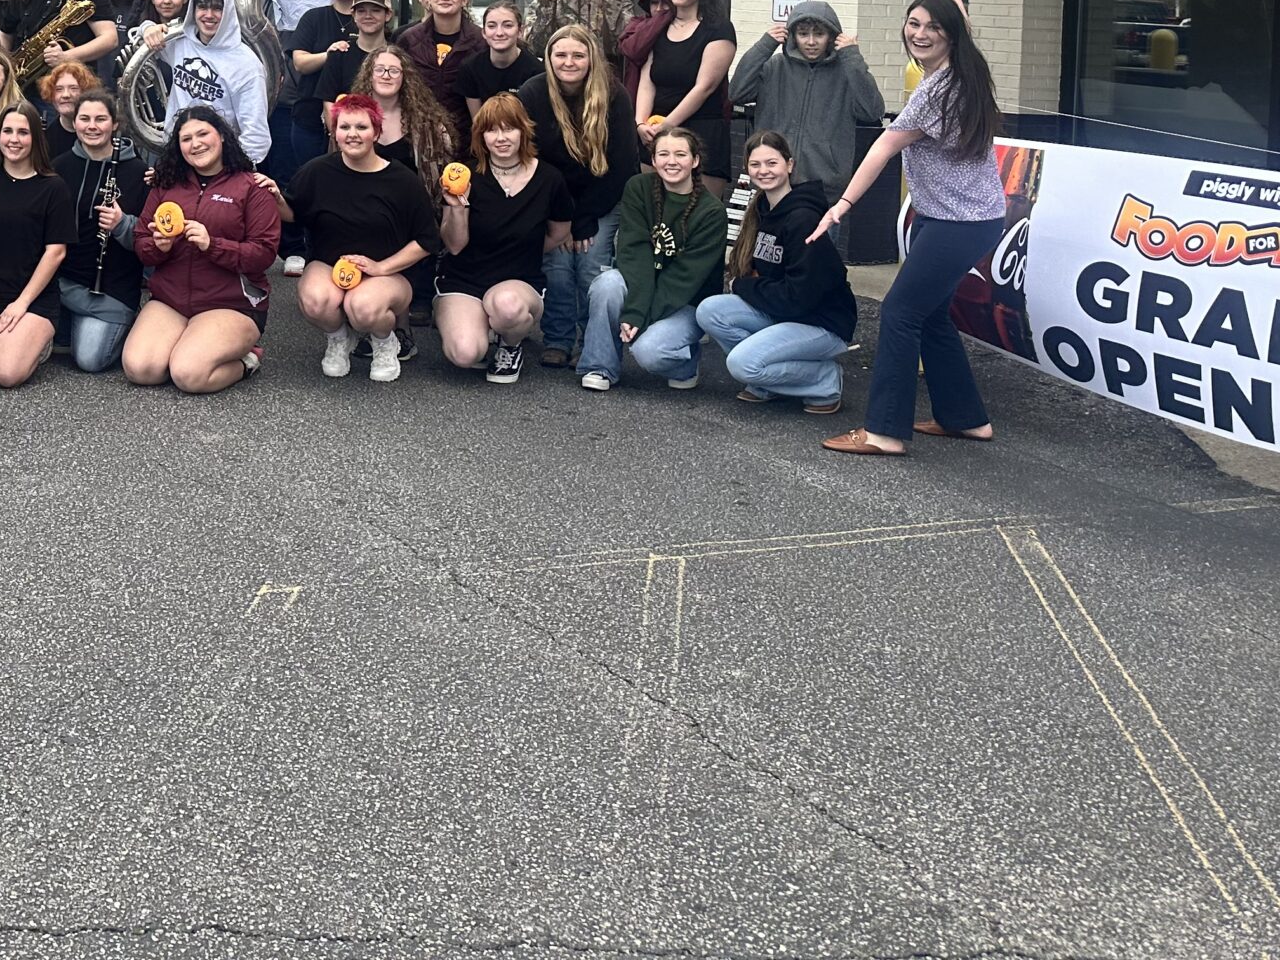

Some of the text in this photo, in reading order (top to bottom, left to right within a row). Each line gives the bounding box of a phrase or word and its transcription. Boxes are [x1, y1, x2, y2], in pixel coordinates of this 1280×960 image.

[778, 5, 793, 17] LA
[1199, 177, 1256, 201] piggly
[1111, 193, 1277, 266] FOOD FOR
[1076, 261, 1280, 366] GRA
